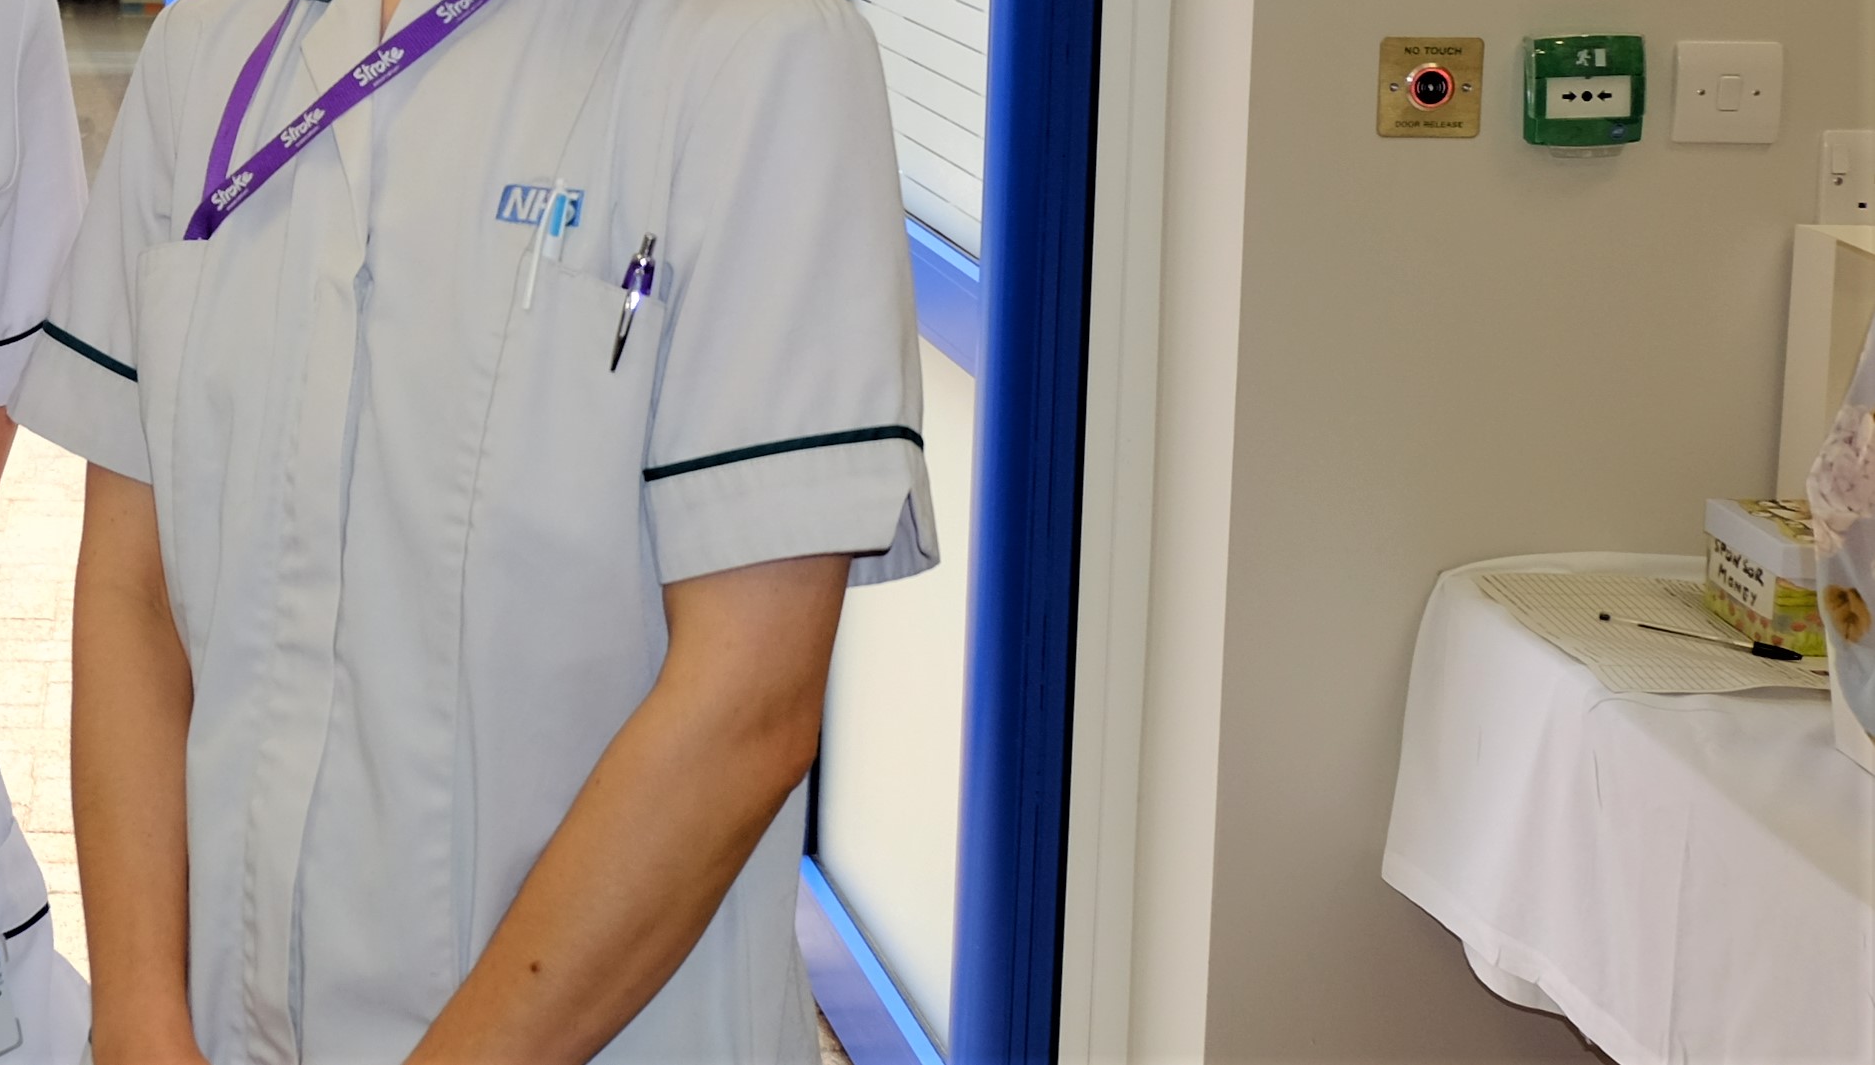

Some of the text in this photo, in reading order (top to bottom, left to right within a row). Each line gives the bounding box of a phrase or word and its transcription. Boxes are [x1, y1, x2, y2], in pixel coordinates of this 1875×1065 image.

[353, 47, 404, 87] Stroke
[1404, 47, 1462, 55] NO TOUCH
[281, 108, 325, 148] Stroke
[1395, 120, 1420, 128] DOOR
[211, 171, 253, 211] Stroke
[1718, 563, 1757, 606] MONEY
